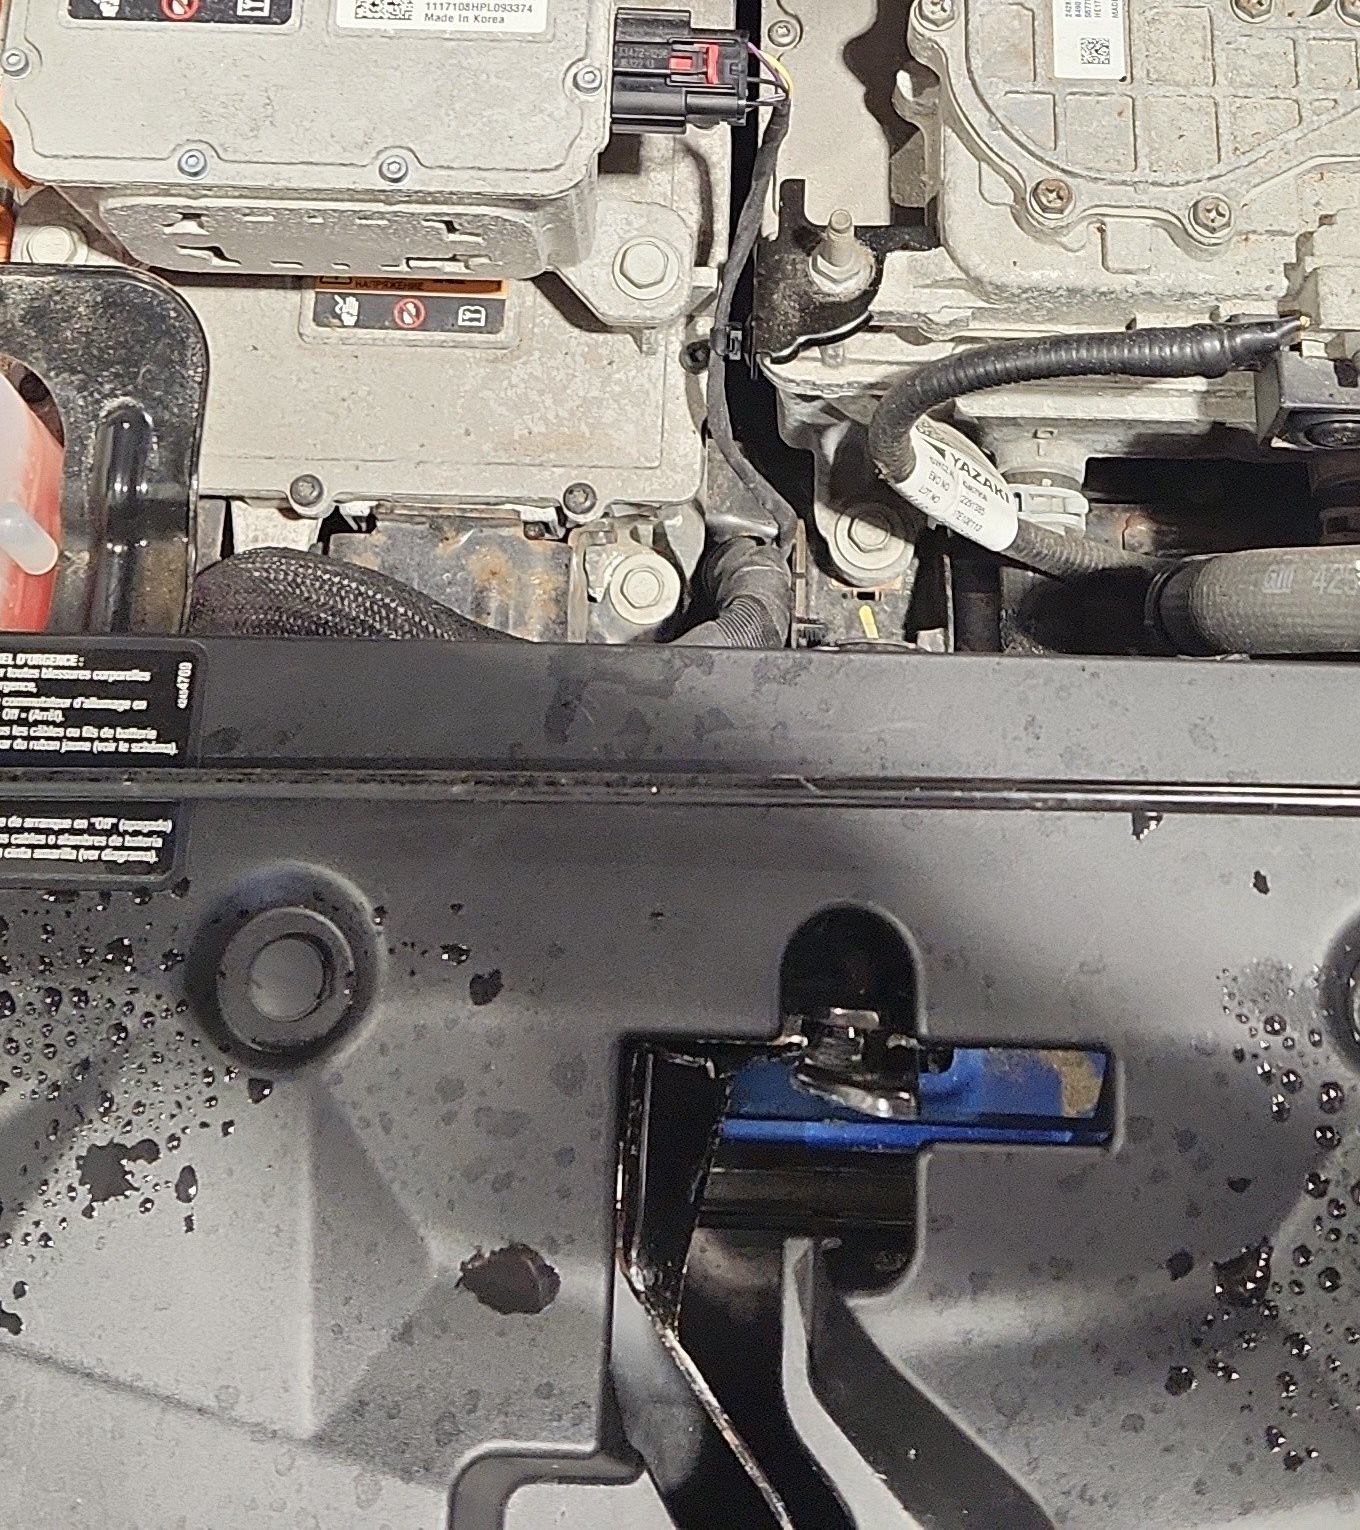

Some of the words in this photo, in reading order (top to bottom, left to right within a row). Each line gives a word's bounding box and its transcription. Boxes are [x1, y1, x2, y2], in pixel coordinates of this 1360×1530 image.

[424, 13, 455, 24] Made
[458, 14, 469, 24] In
[473, 14, 506, 25] Korea
[354, 279, 425, 292] НАПРЯЖЕНИЕ
[950, 452, 1010, 504] YAZAKI
[40, 667, 91, 679] blessures
[92, 669, 151, 683] corporelles
